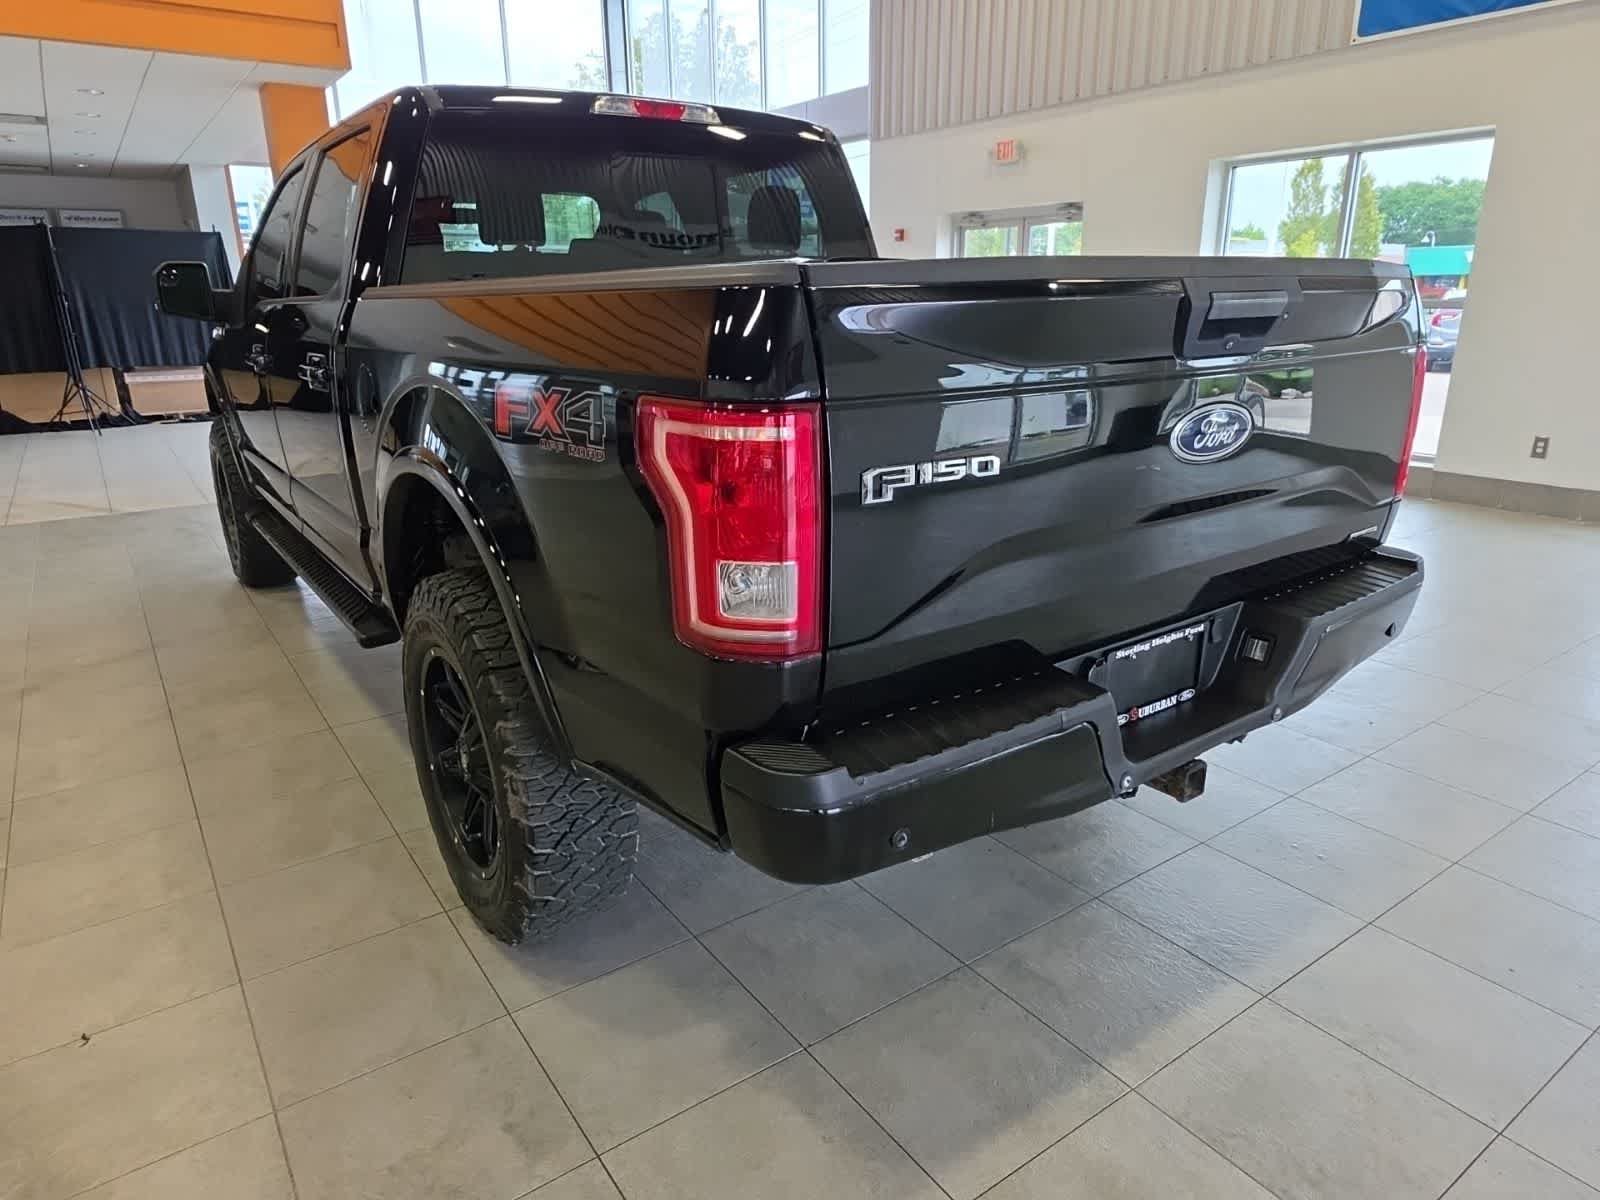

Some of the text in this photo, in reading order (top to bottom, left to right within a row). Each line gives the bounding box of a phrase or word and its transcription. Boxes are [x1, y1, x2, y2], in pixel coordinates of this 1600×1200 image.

[996, 141, 1015, 161] EXIT
[495, 381, 606, 449] FX4
[1193, 416, 1240, 449] Ford
[1151, 631, 1184, 647] Heights
[1129, 694, 1178, 721] SUBURBAN
